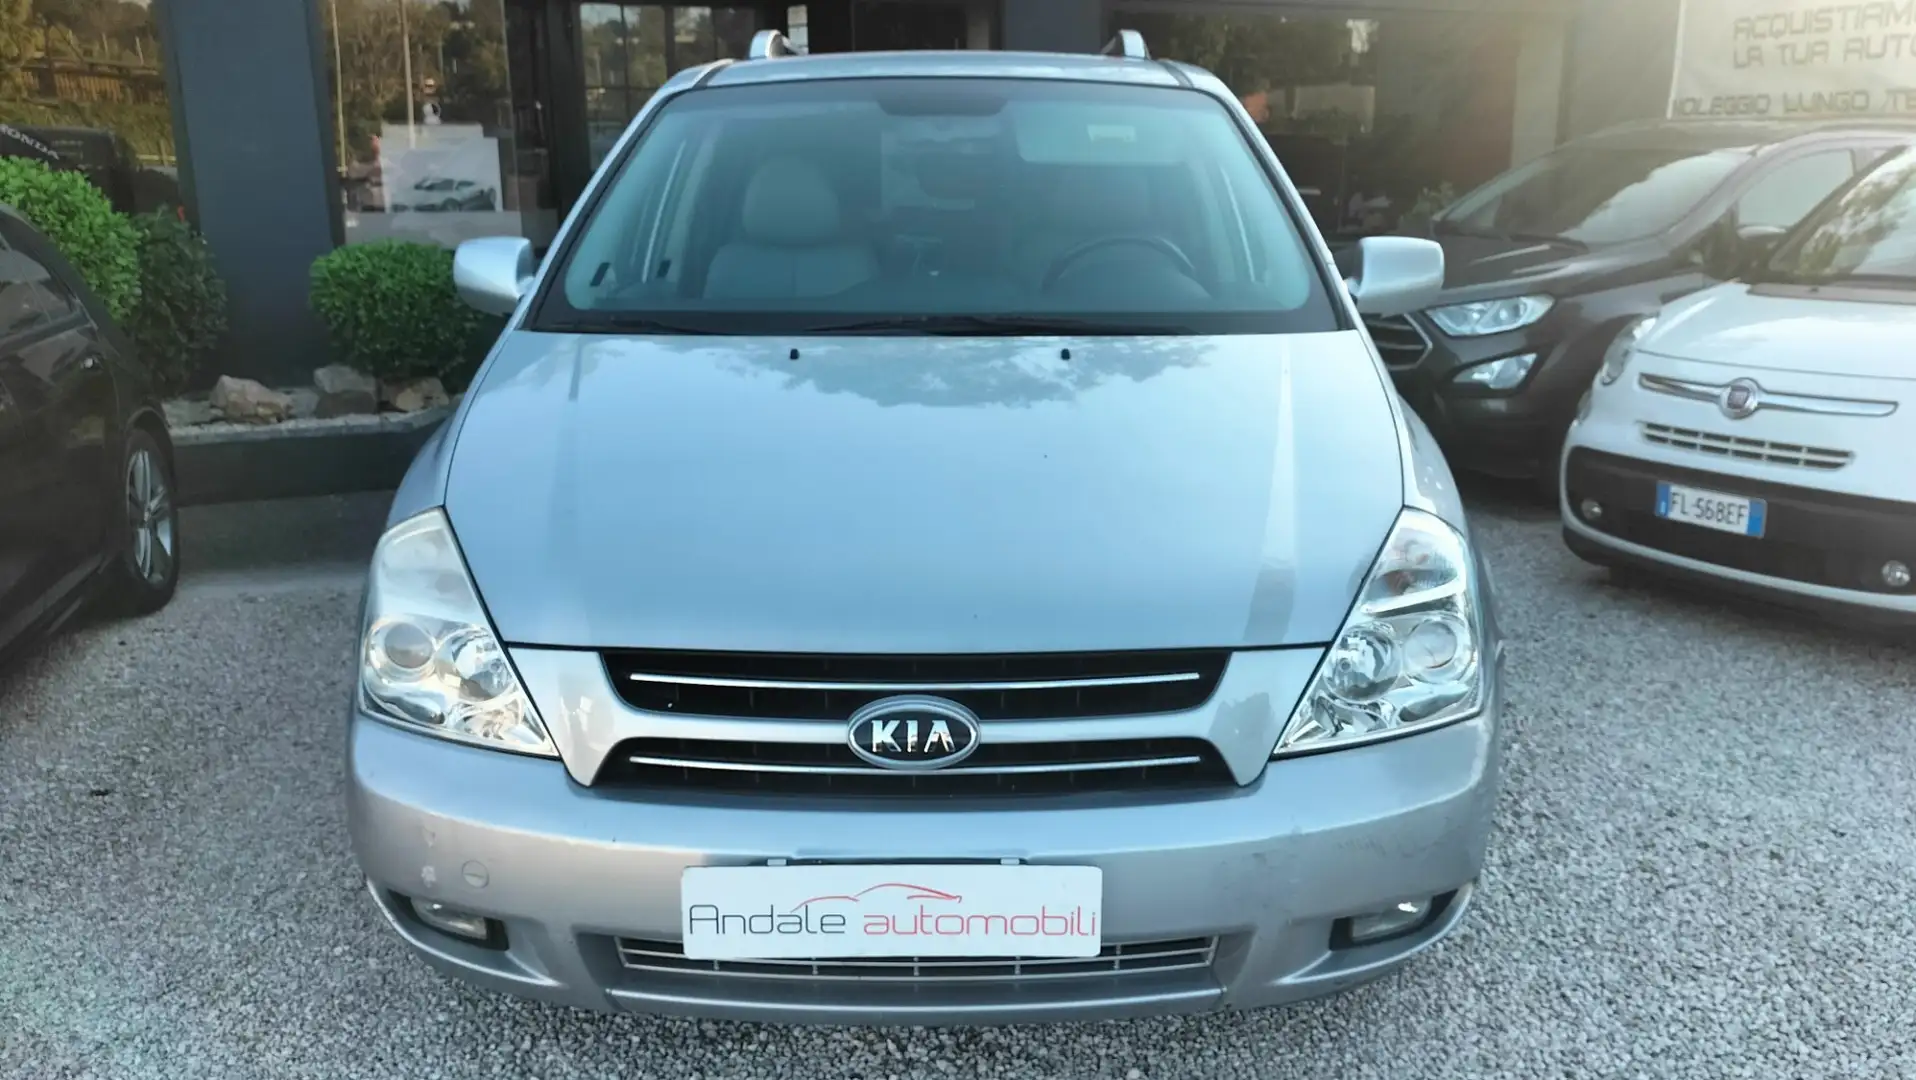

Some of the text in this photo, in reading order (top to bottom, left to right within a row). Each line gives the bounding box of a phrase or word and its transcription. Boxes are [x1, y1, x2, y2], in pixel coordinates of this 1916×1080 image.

[1733, 0, 1916, 40] ACQUISTIAM
[1733, 46, 1764, 69] LA
[1777, 40, 1829, 67] TUA
[1783, 90, 1869, 114] LUNGO
[871, 719, 957, 753] KIA
[689, 904, 1097, 936] Andale automobili
